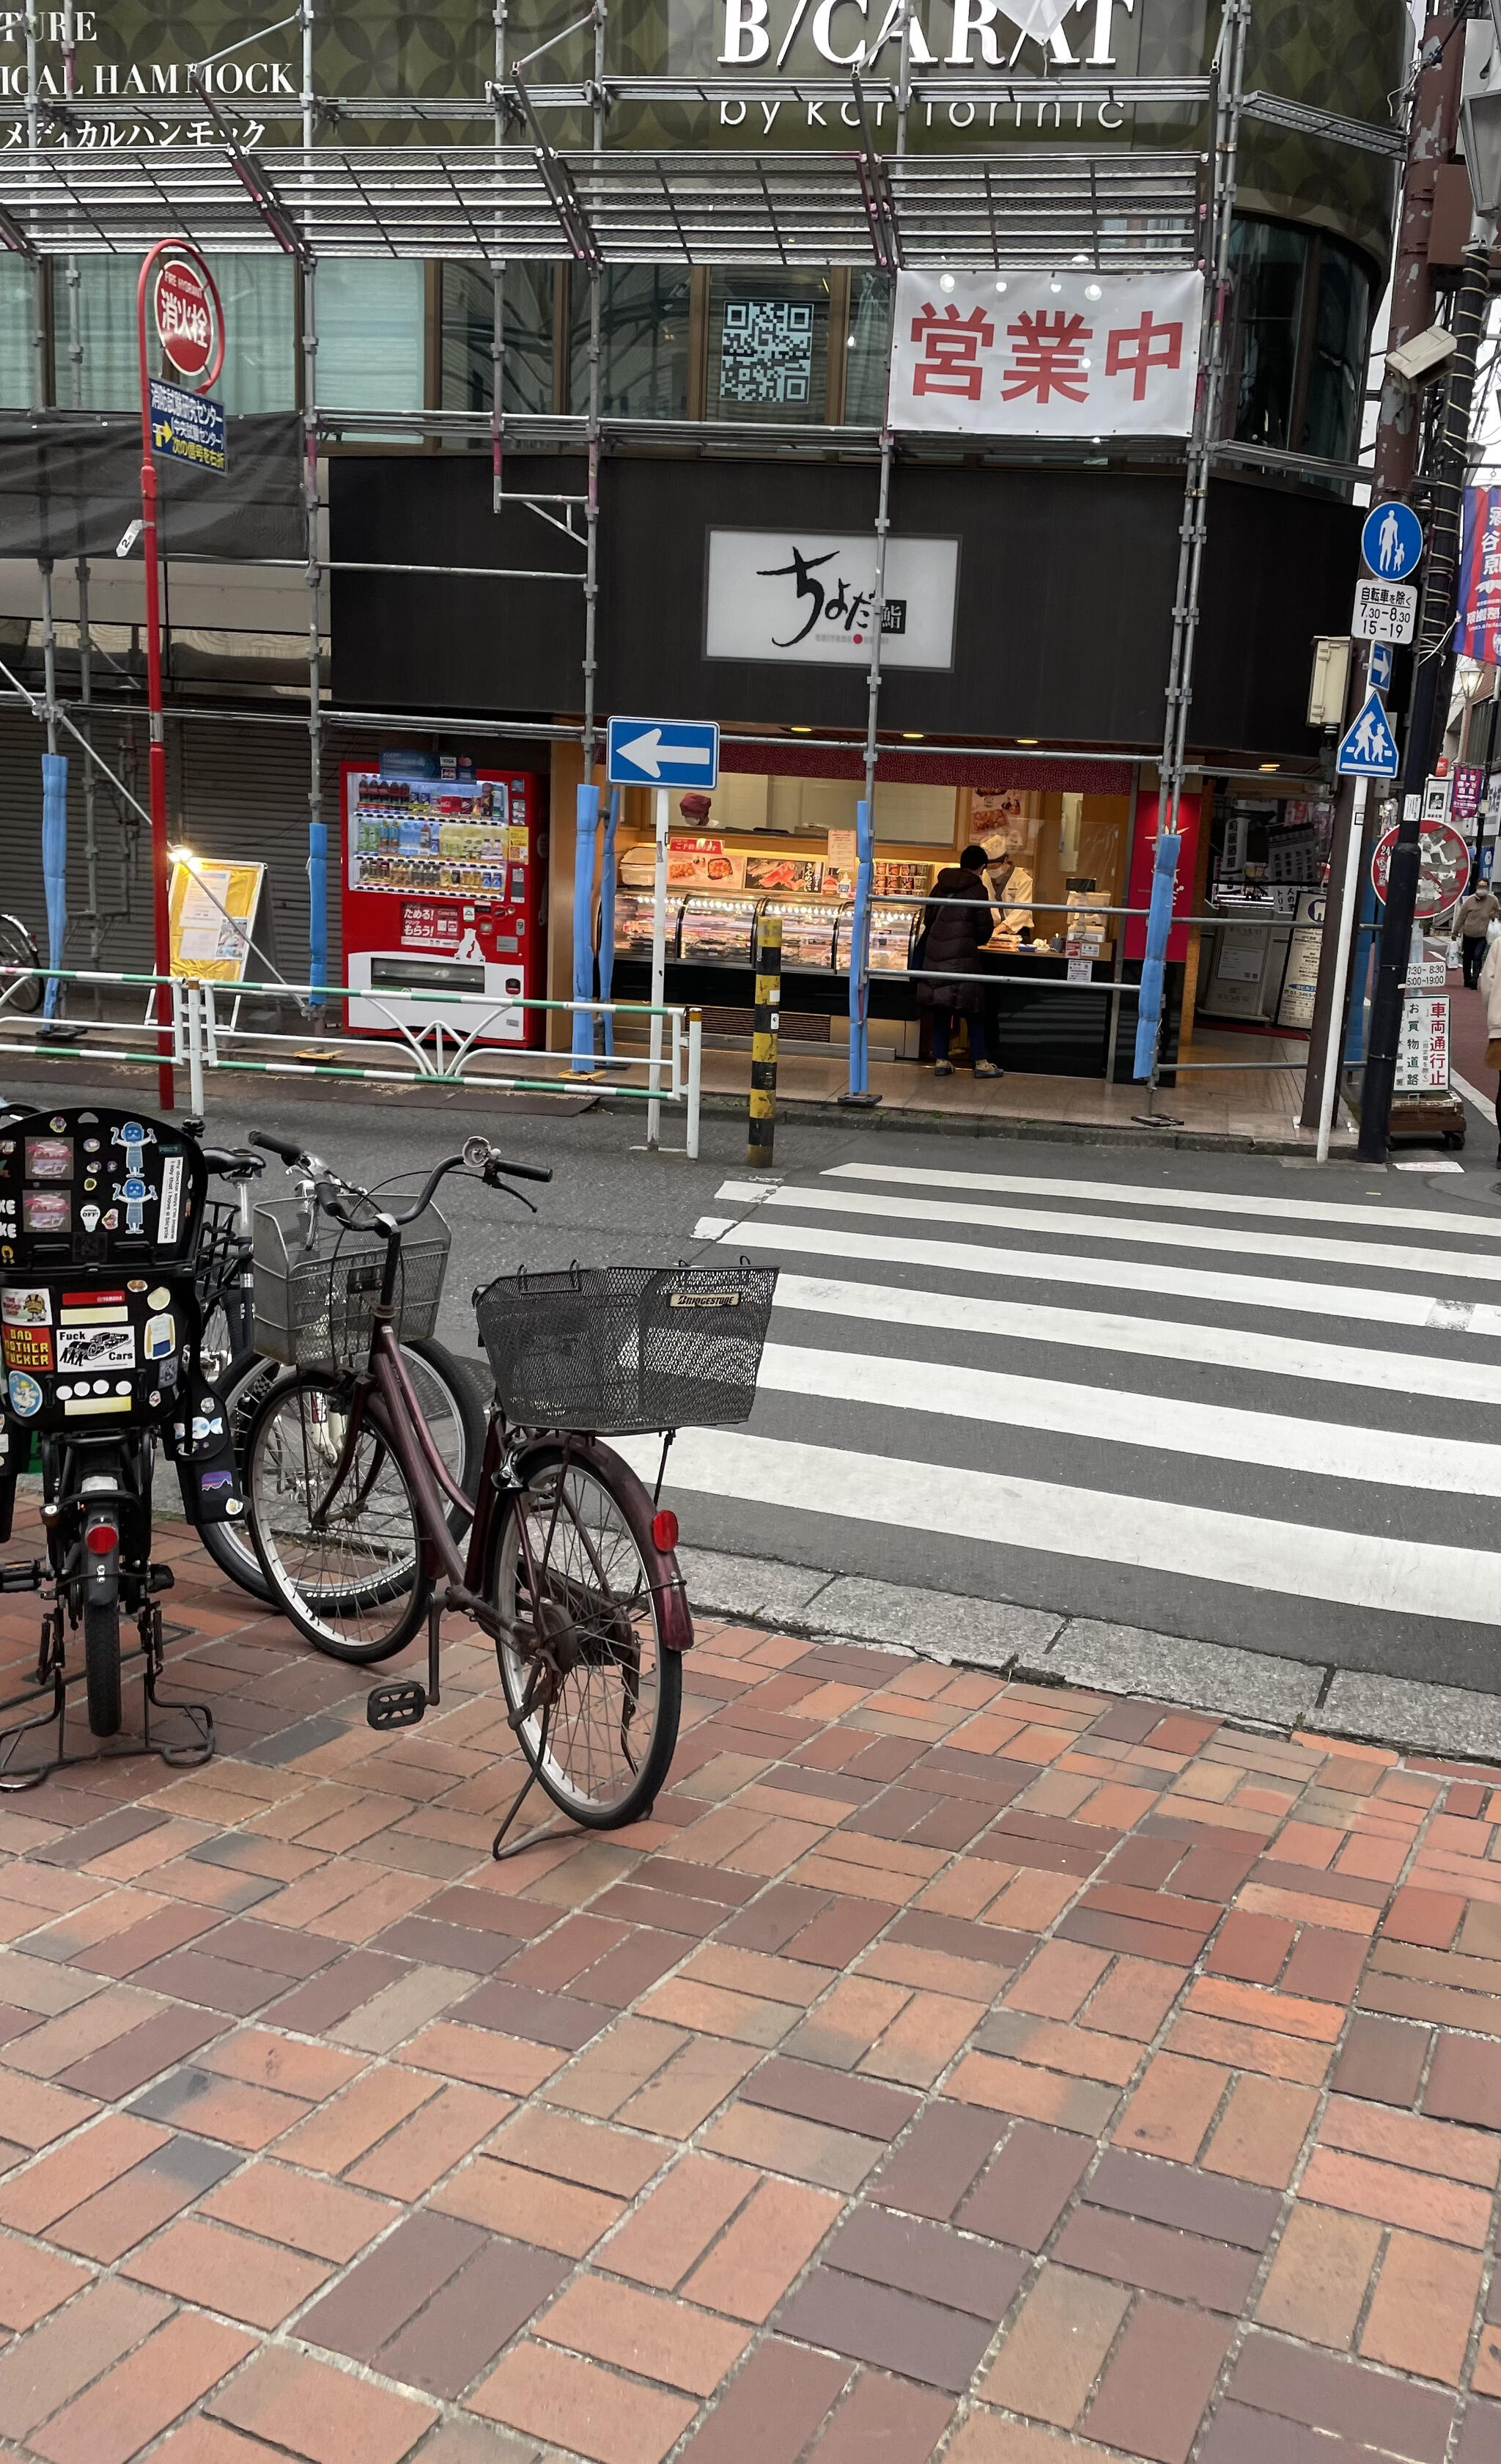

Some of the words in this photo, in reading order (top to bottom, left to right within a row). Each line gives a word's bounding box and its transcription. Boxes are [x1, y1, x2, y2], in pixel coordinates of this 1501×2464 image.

[93, 63, 296, 95] HAMMOCK
[161, 288, 208, 348] 消火栓
[910, 301, 1184, 404] 営業中
[1361, 586, 1412, 606] 自転車を除く
[1407, 1003, 1420, 1086] お買物道路
[1429, 1003, 1446, 1086] 車両通行止
[59, 1331, 86, 1341] Fuck
[108, 1352, 133, 1361] Cars
